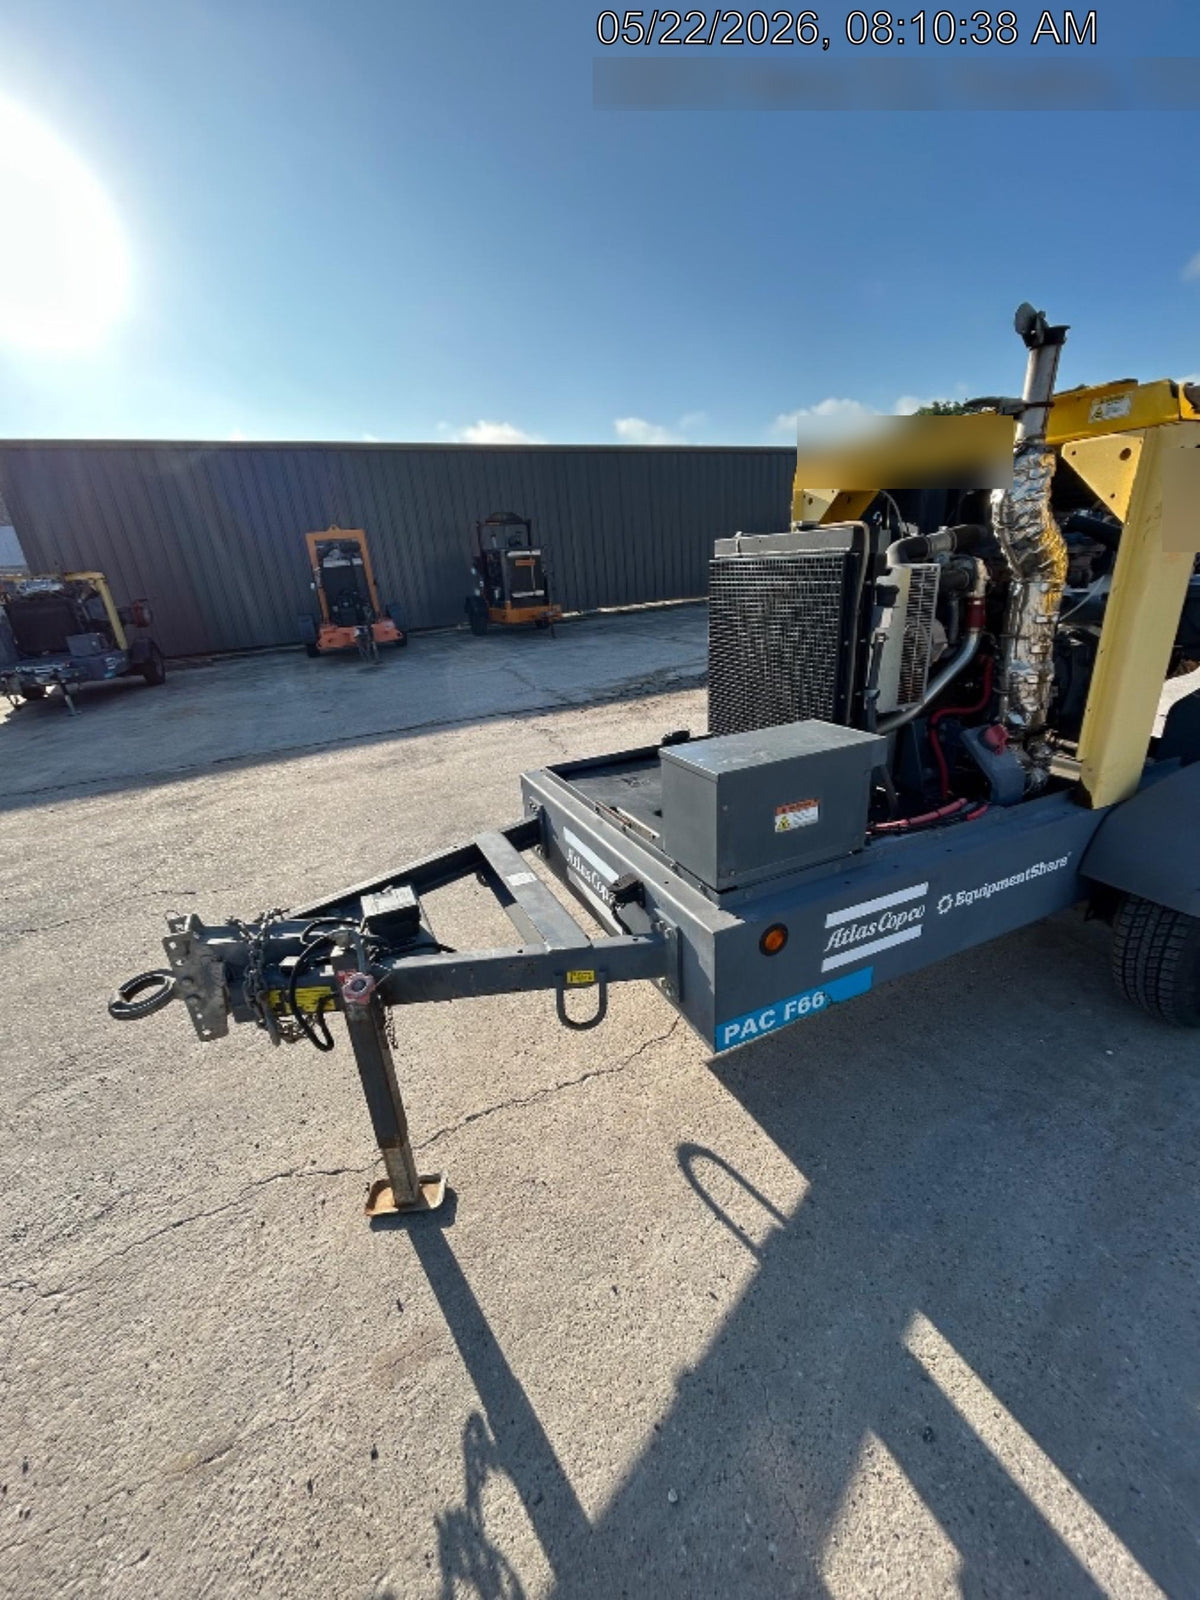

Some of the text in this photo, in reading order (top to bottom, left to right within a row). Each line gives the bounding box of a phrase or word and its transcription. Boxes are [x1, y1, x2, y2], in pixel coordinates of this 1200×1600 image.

[955, 856, 1068, 906] EquipmentShare
[824, 905, 926, 952] Atlas Copco
[724, 991, 825, 1044] PAC F66
